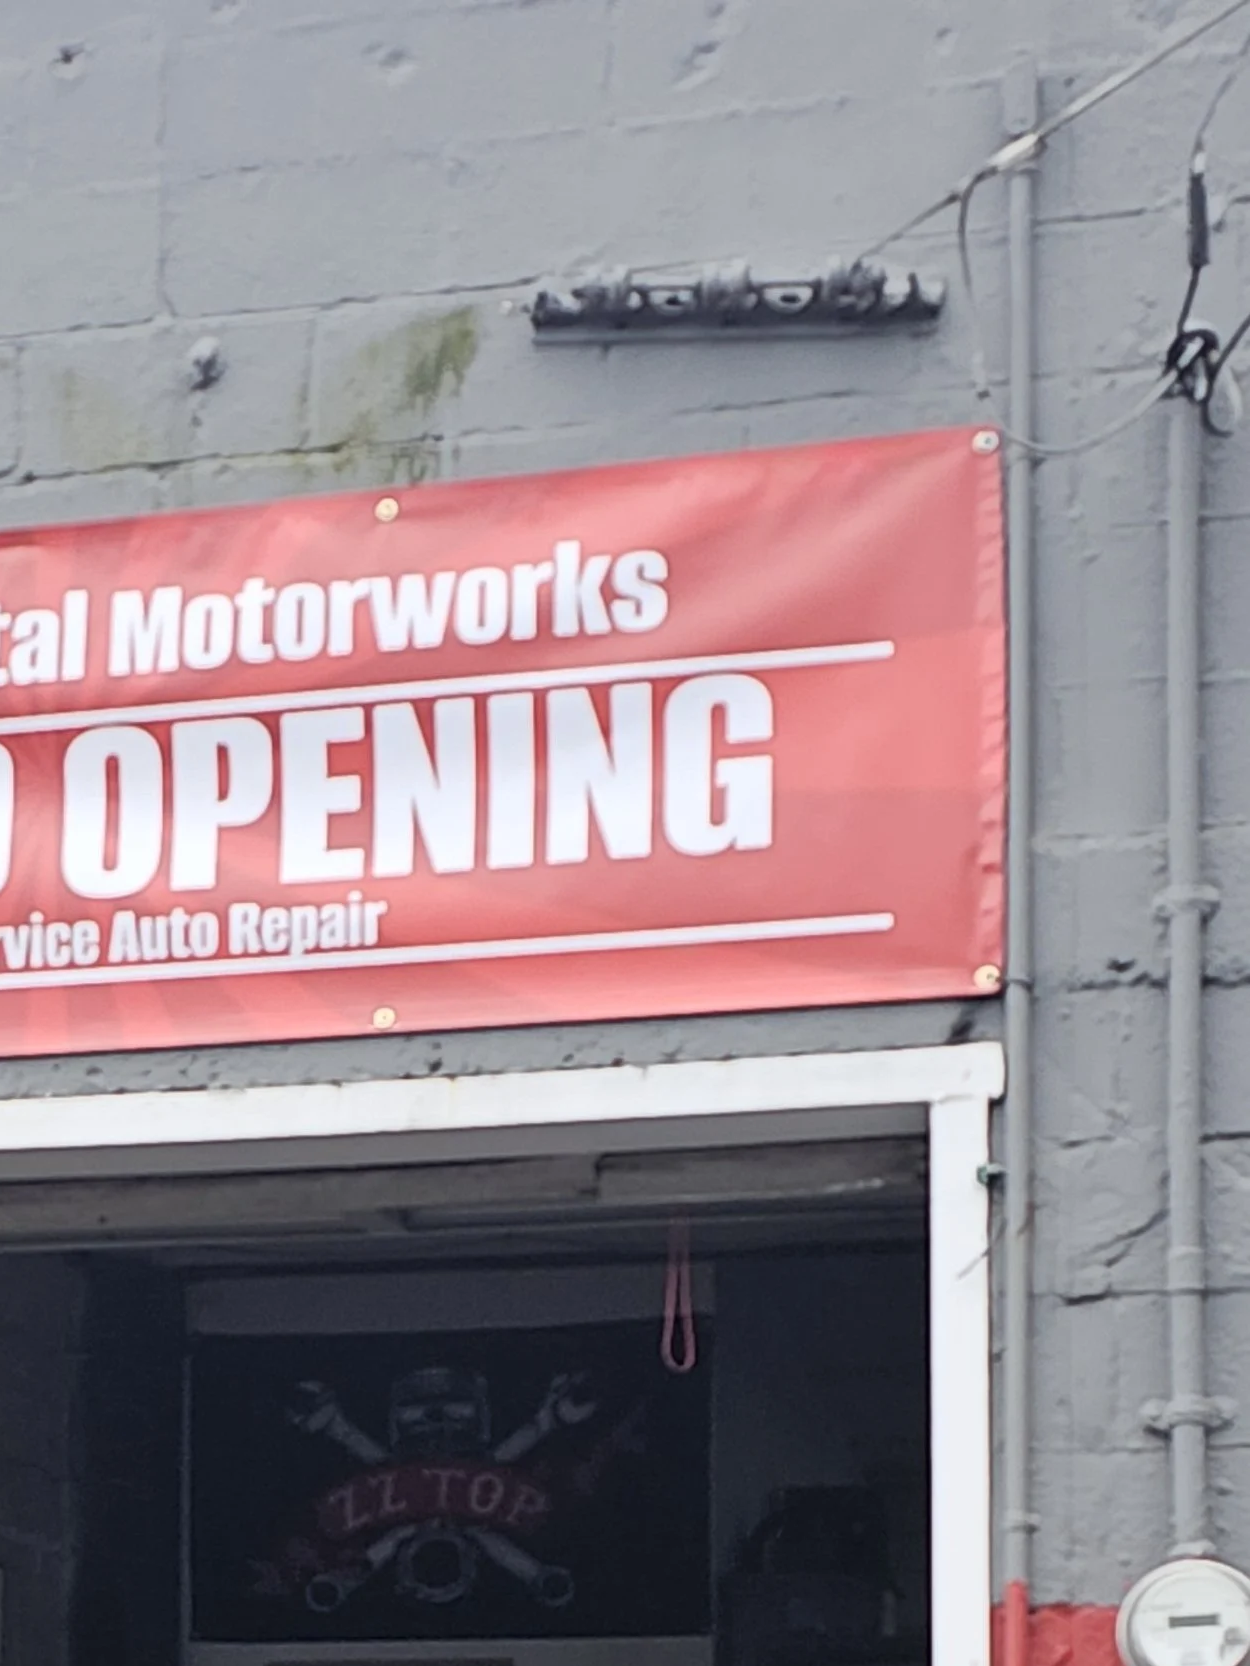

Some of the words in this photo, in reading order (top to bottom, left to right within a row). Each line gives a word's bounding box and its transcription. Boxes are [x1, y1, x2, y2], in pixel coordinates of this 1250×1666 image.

[107, 539, 669, 678] Motorworks
[60, 672, 774, 899] OPENING
[107, 906, 220, 964] Auto
[227, 890, 388, 958] Repair
[329, 1470, 408, 1531] ZZ
[421, 1468, 553, 1525] TOP
